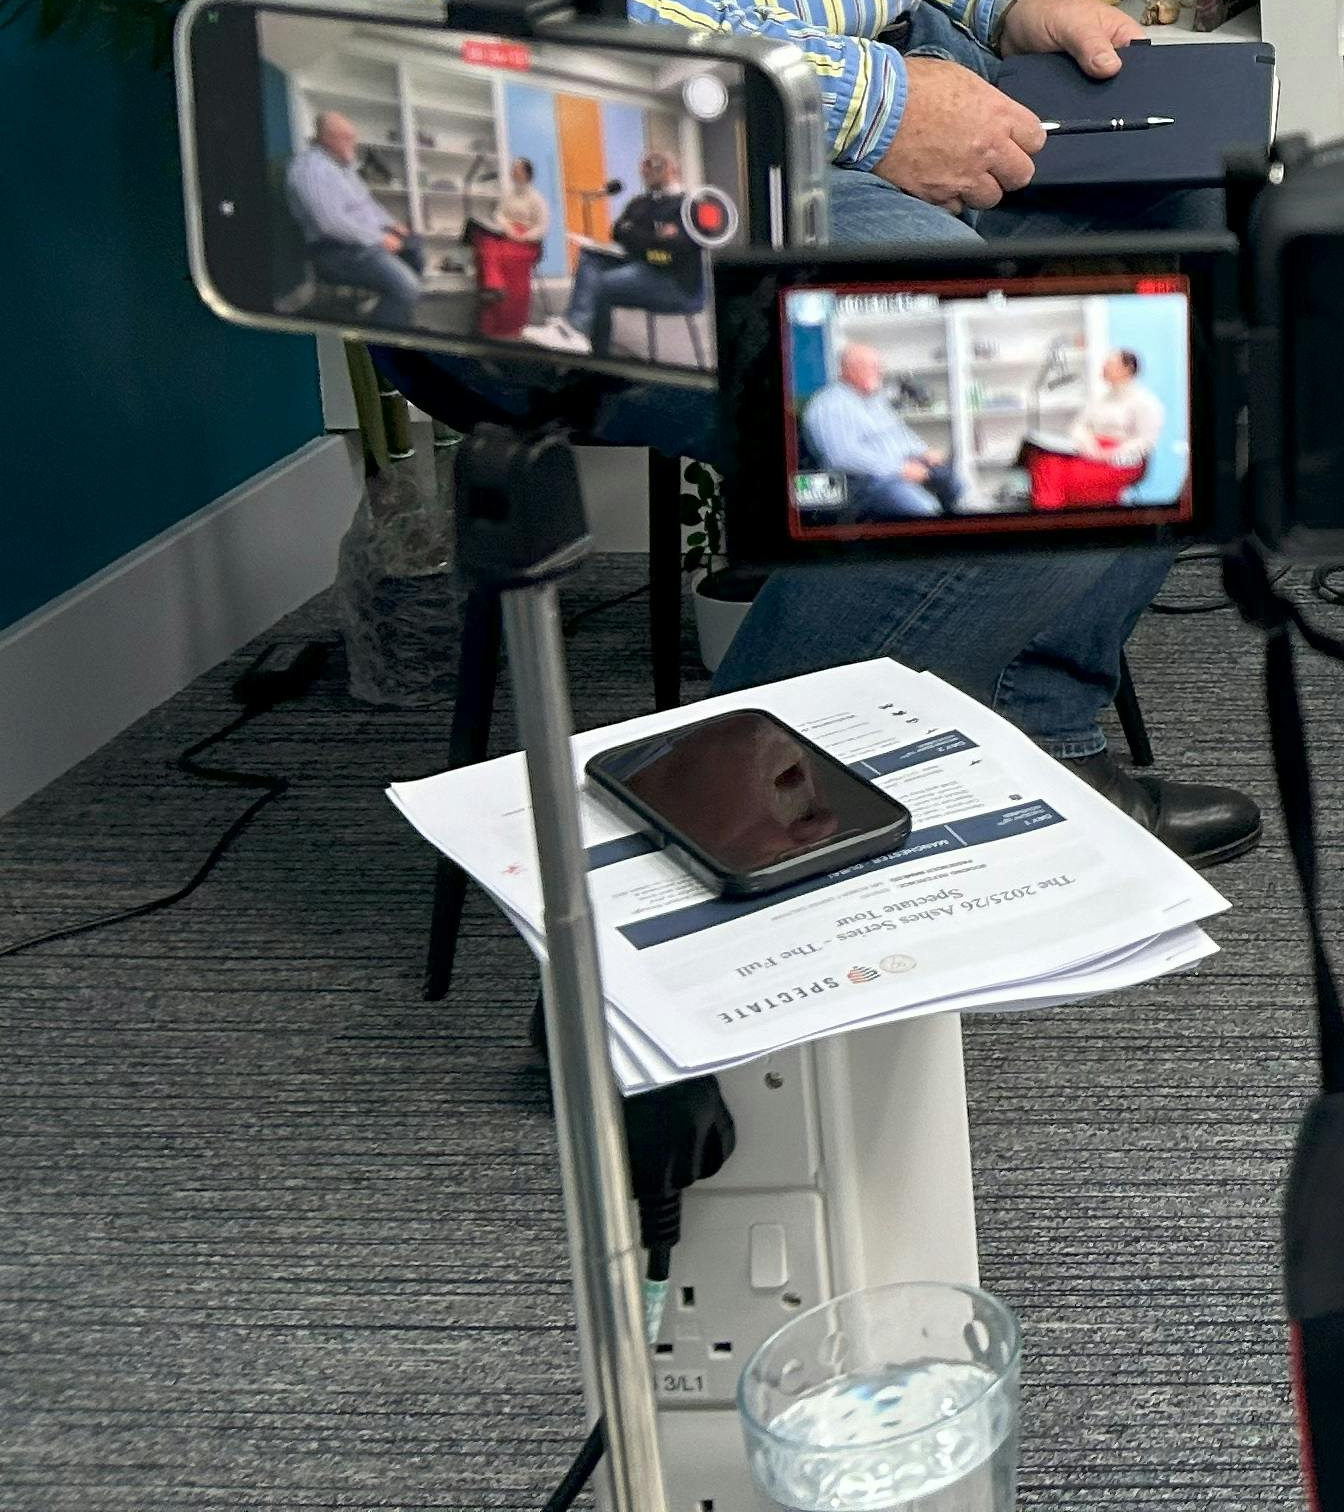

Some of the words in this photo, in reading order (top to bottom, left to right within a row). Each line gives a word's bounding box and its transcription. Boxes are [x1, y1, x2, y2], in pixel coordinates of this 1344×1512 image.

[1038, 874, 1077, 890] The
[883, 888, 965, 913] Spectate
[961, 884, 1037, 912] 2025/26
[835, 909, 882, 928] Tour
[900, 904, 955, 925] Ashes
[836, 920, 898, 942] Series
[780, 943, 823, 959] The
[735, 956, 778, 977] Full
[719, 977, 840, 1024] SPECTATE
[664, 1374, 703, 1392] 3/L1
